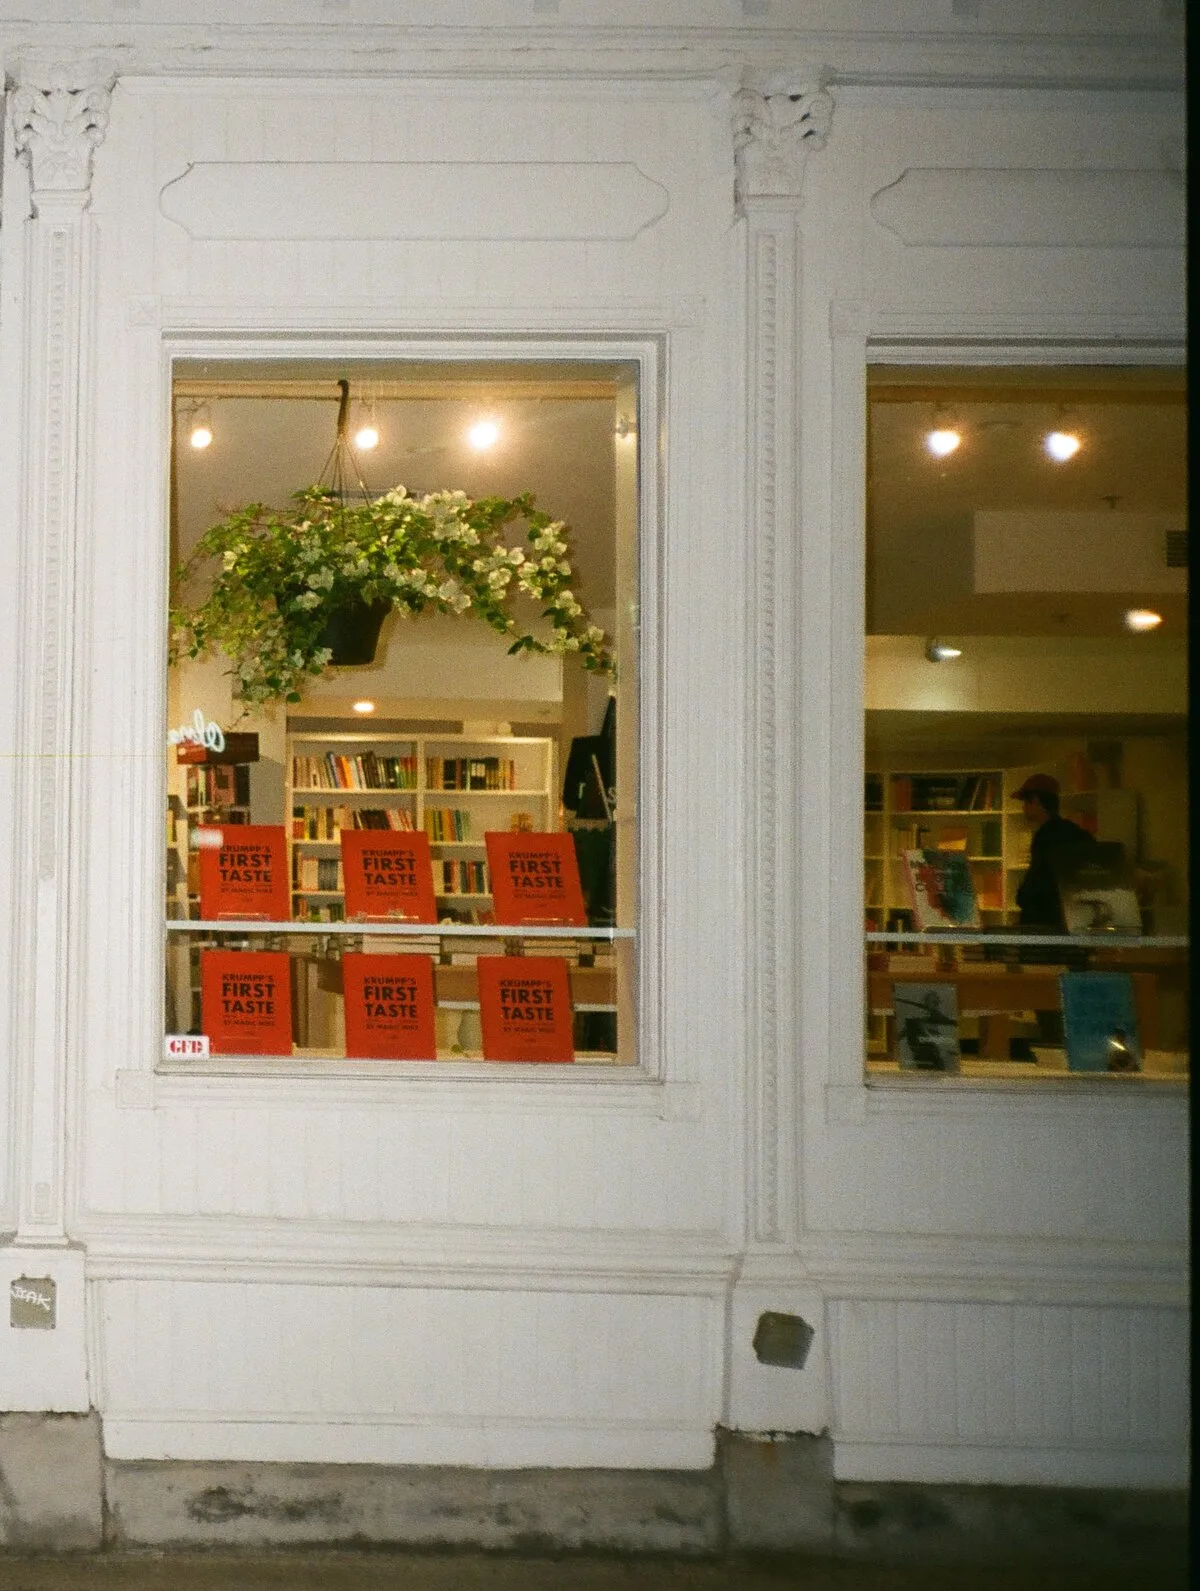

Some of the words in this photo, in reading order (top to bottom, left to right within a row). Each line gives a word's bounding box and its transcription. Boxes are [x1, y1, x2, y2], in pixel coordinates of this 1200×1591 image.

[219, 853, 273, 867] FIRST
[362, 858, 416, 871] FIRST
[509, 860, 562, 874] FIRST
[220, 869, 272, 883] TASTE
[364, 873, 417, 886] TASTE
[511, 875, 564, 889] TASTE
[222, 983, 276, 999] FIRST
[363, 986, 418, 1001] FIRST
[500, 989, 554, 1004] FIRST
[222, 1000, 275, 1014] TASTE
[364, 1003, 418, 1018] TASTE
[501, 1006, 554, 1021] TASTE
